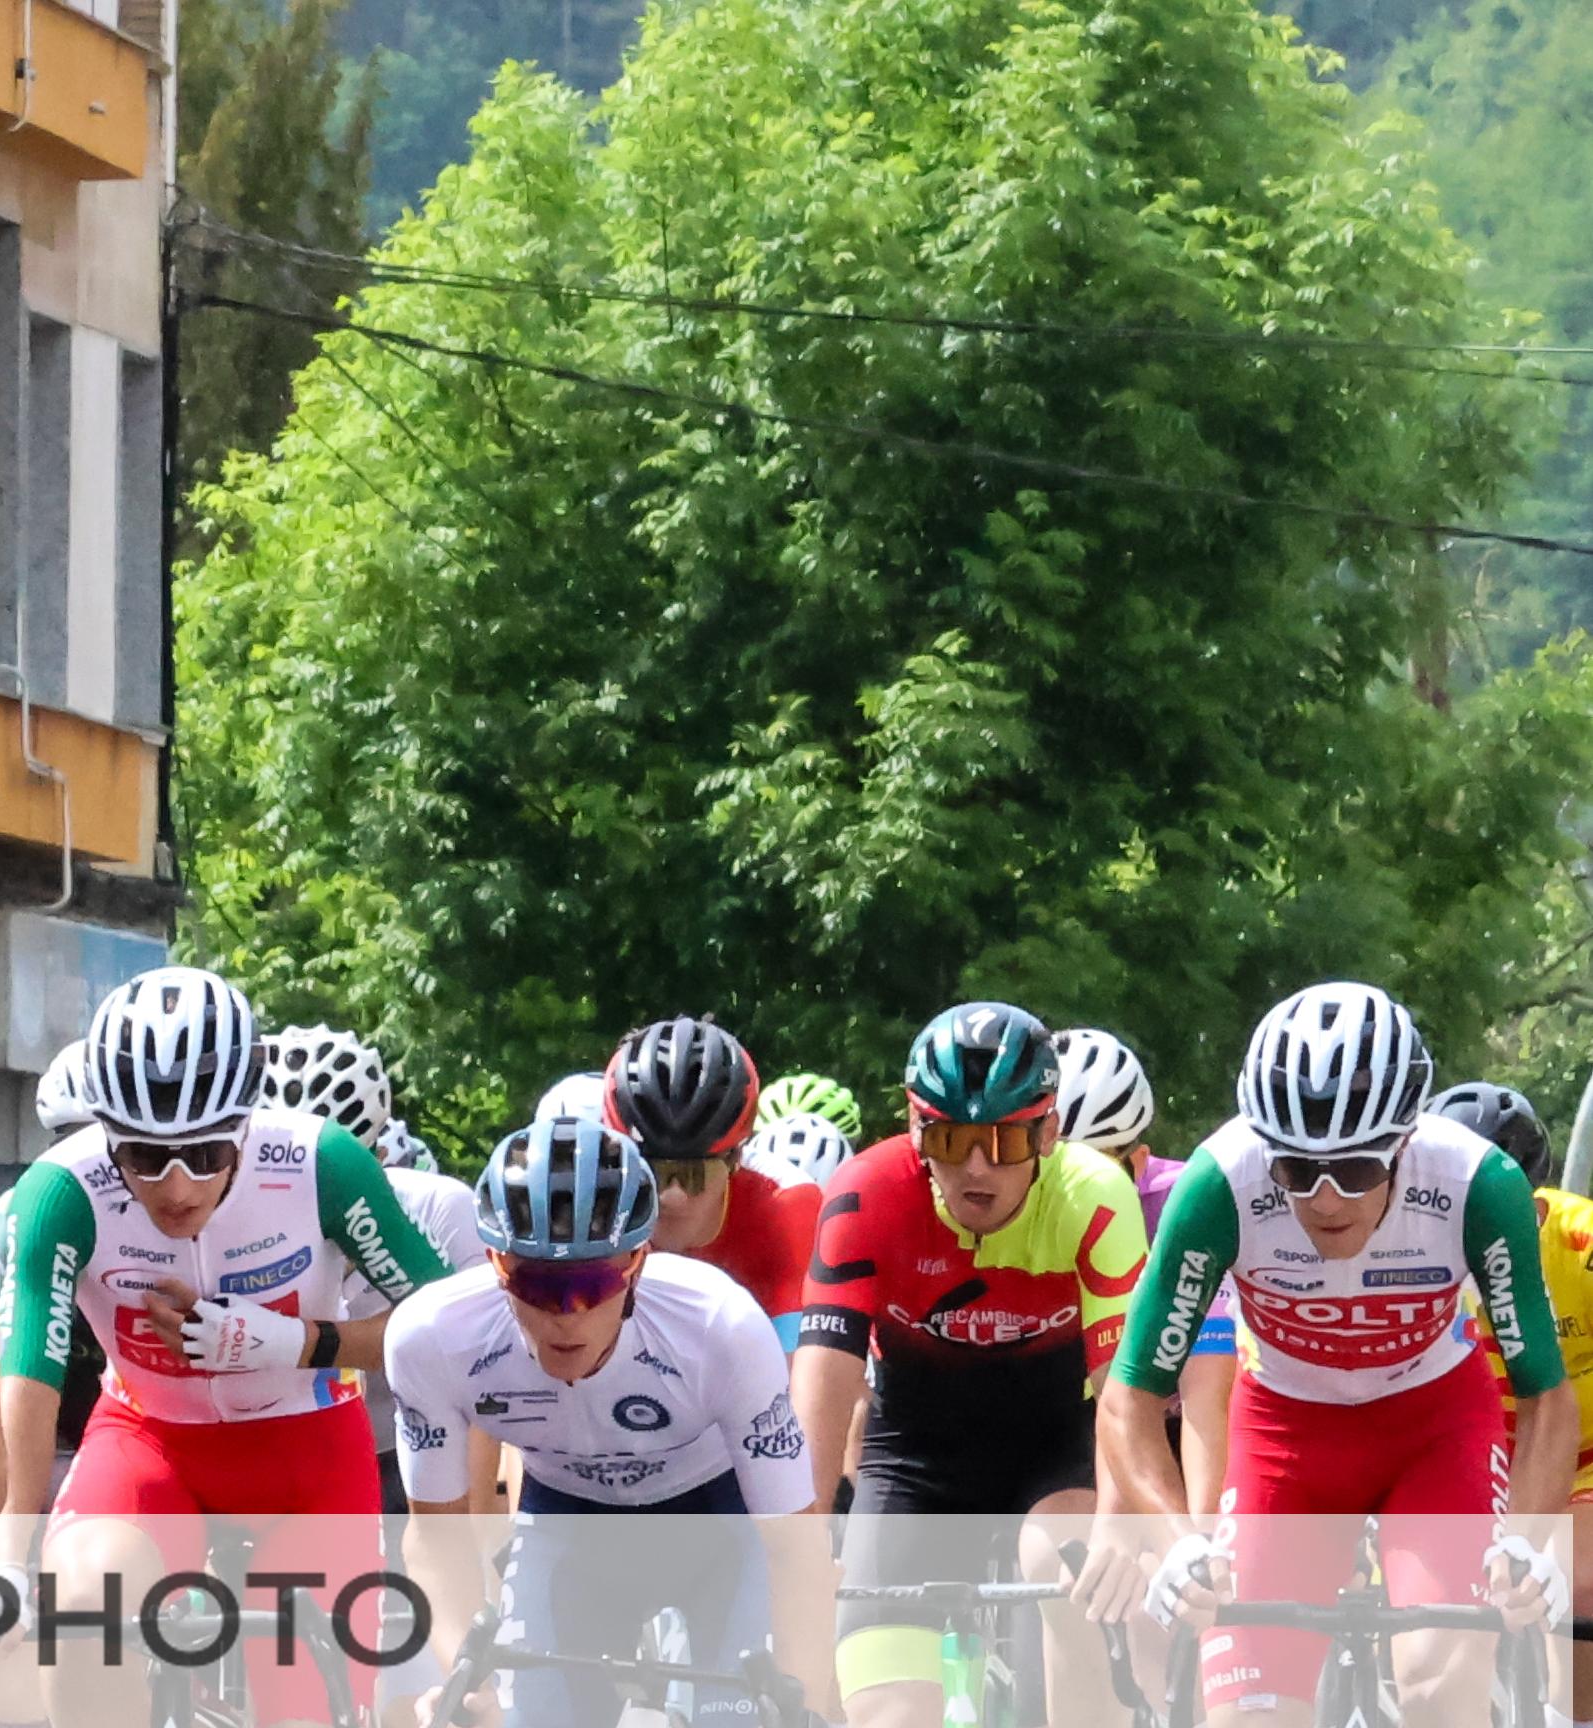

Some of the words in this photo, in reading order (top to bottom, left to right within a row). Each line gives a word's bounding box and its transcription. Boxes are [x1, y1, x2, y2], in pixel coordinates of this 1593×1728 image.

[258, 1141, 306, 1164] solo
[1404, 1186, 1452, 1213] solo
[118, 1245, 177, 1265] GSPORT
[344, 1196, 414, 1300] KOMETA
[228, 1253, 308, 1292] FINECO
[44, 1242, 79, 1367] KOMETA
[1152, 1250, 1210, 1371] KOMETA
[1253, 1292, 1448, 1327] POLTI
[1483, 1236, 1526, 1360] KOMETA
[887, 1304, 1079, 1346] CALLEJO
[931, 1308, 1040, 1328] RECAMBIOS
[1097, 1325, 1126, 1348] ULE
